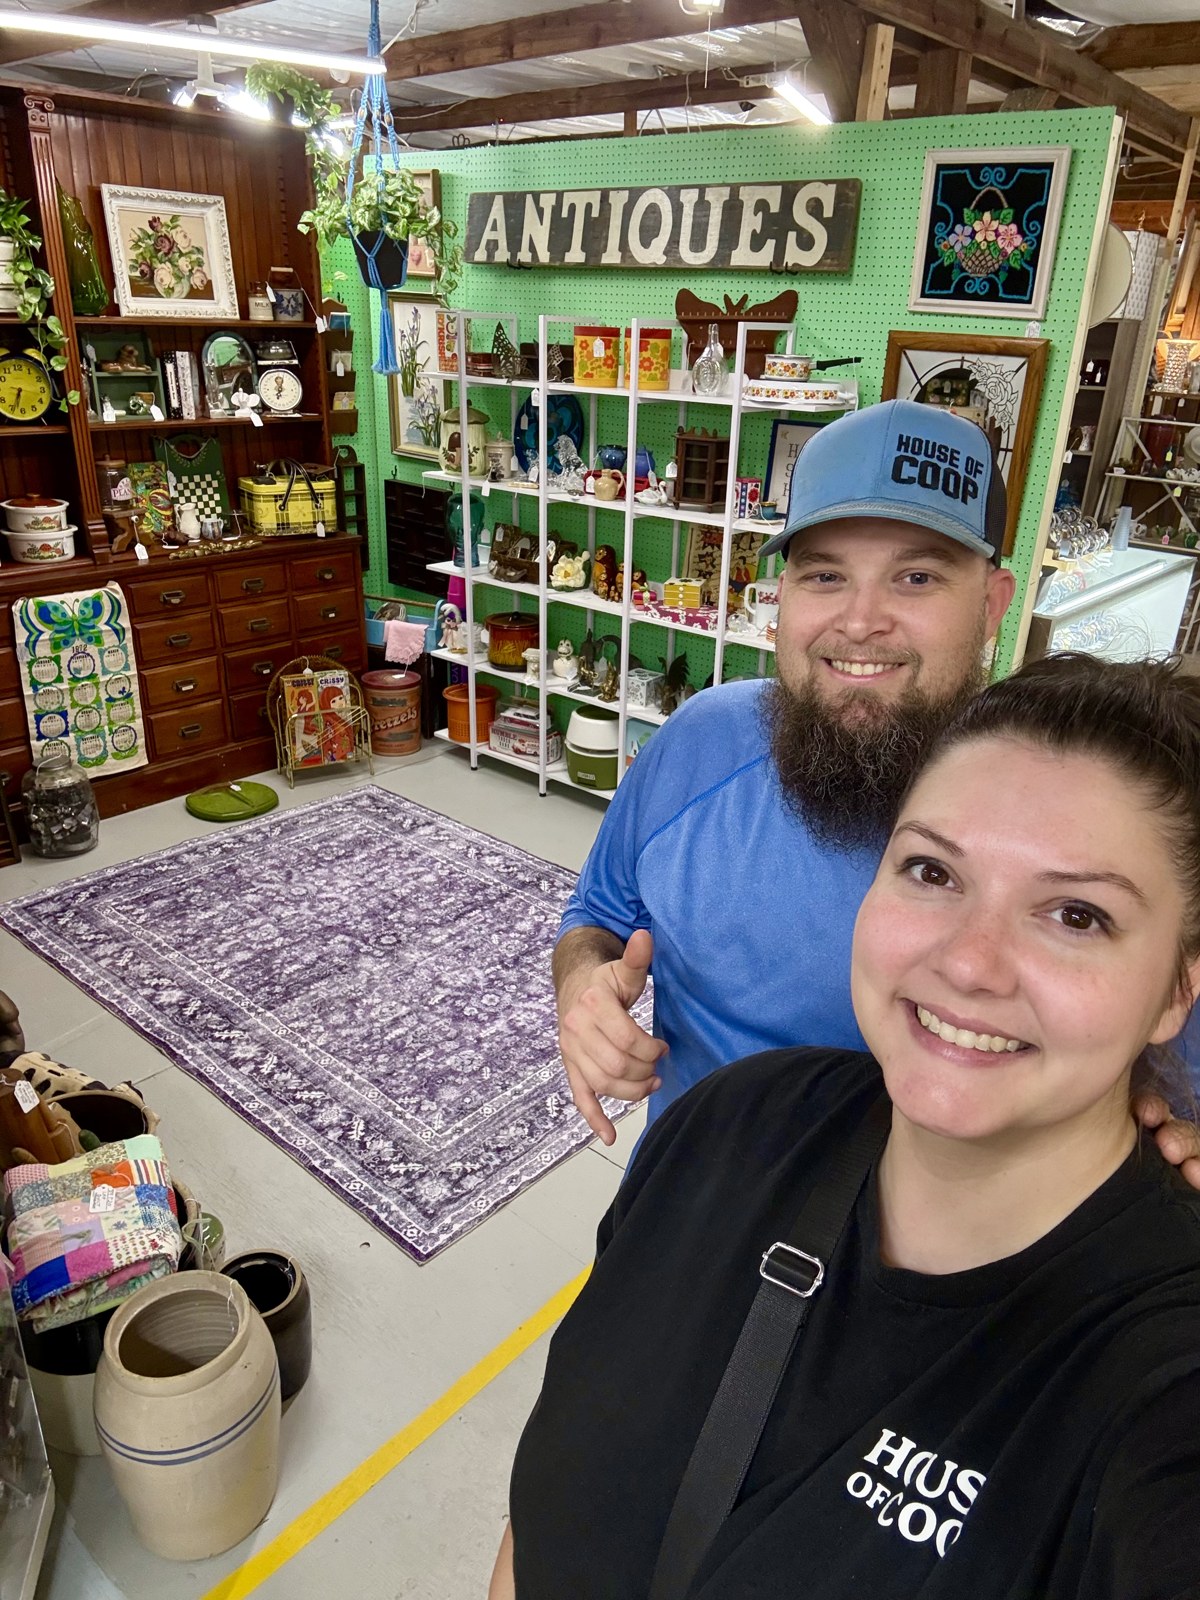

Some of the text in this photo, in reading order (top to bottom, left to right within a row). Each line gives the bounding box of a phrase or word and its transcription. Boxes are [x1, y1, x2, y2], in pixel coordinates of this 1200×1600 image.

[473, 182, 837, 267] ANTIQUES
[3, 367, 11, 375] 11
[40, 386, 46, 394] 3
[0, 396, 6, 404] 8
[38, 397, 43, 405] 4
[20, 407, 26, 415] 6
[896, 433, 984, 479] HOUSE OF
[891, 454, 979, 506] COOP
[72, 644, 88, 653] 1972
[846, 1471, 892, 1509] OF
